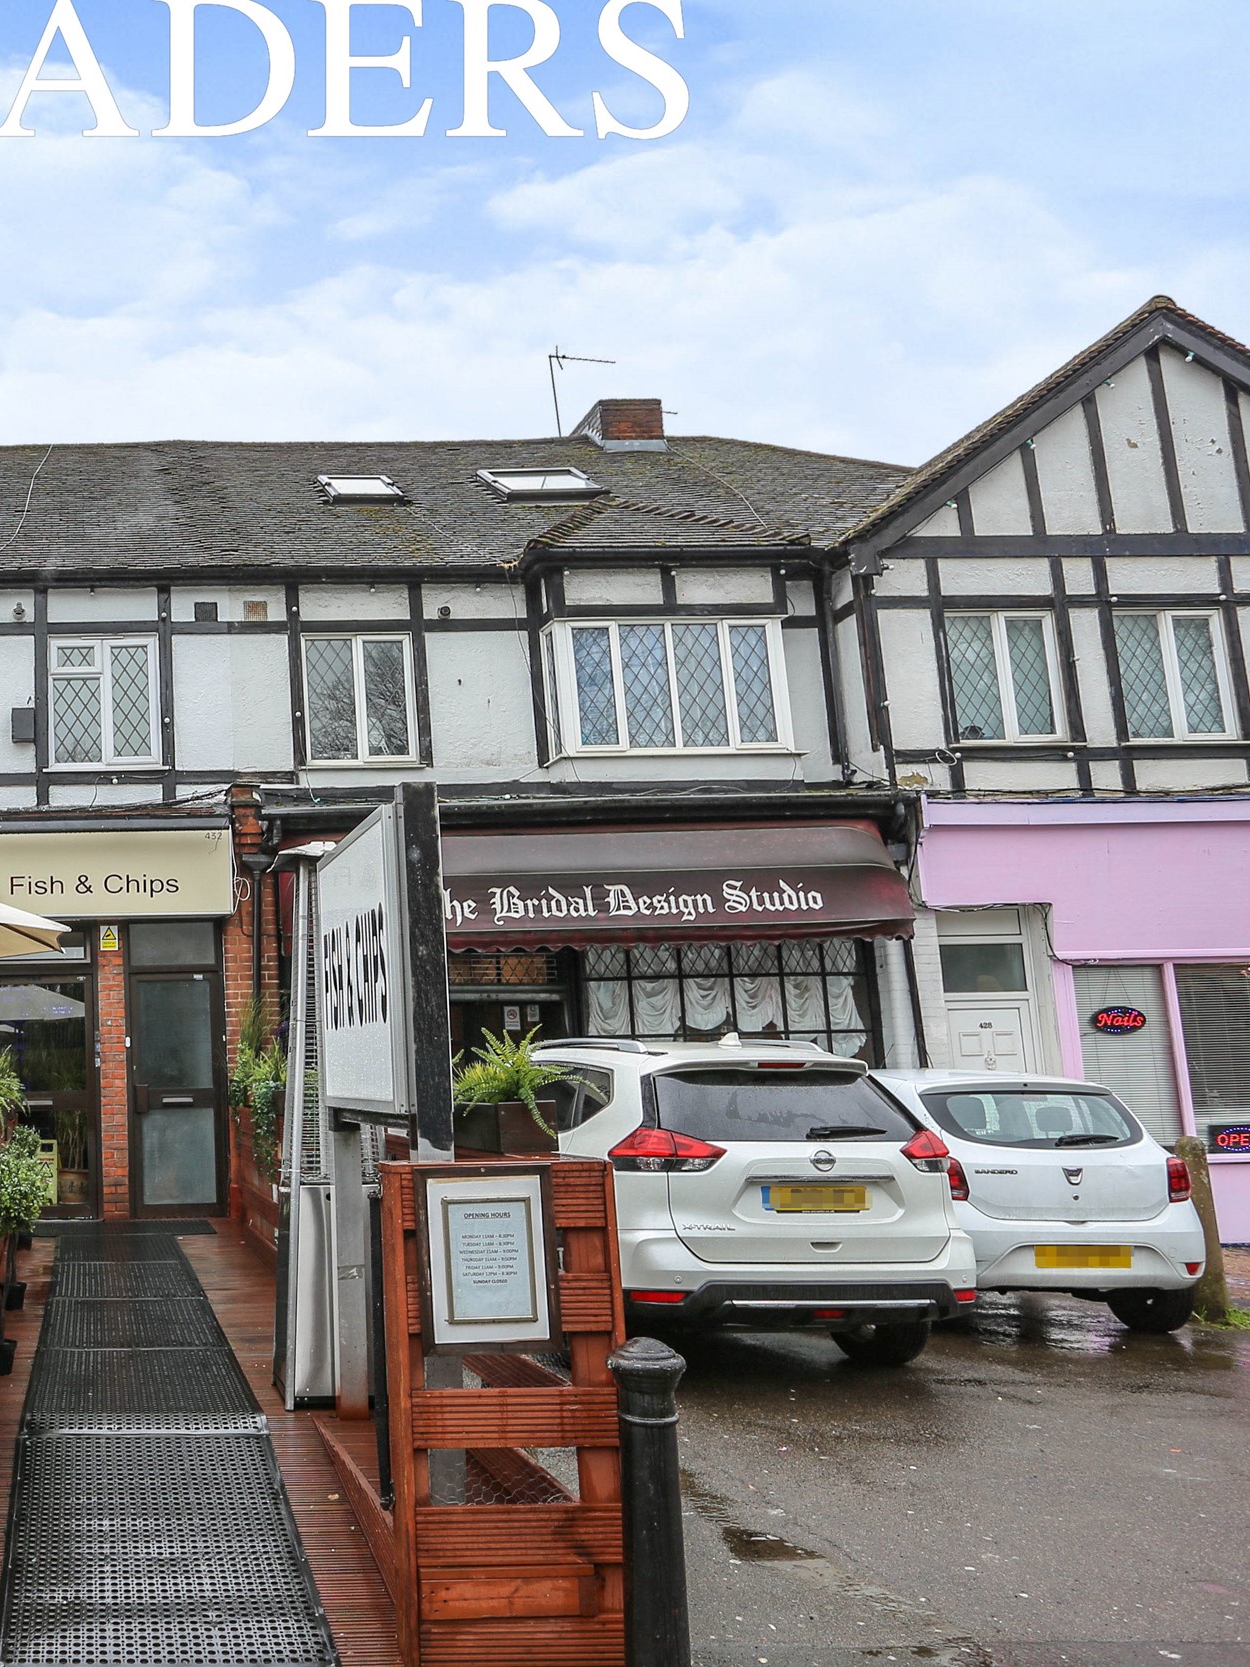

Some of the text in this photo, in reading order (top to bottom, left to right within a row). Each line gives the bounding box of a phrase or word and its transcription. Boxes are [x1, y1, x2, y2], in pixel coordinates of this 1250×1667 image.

[204, 832, 223, 840] 432
[9, 873, 180, 898] Fish & Chips
[442, 879, 824, 927] he Bridal Design Studio
[323, 901, 388, 1031] FISH & CHIPS
[978, 1021, 993, 1029] 428
[1096, 1012, 1144, 1027] Nails
[1216, 1133, 1250, 1147] OPE
[681, 1223, 736, 1231] X-TRAIL
